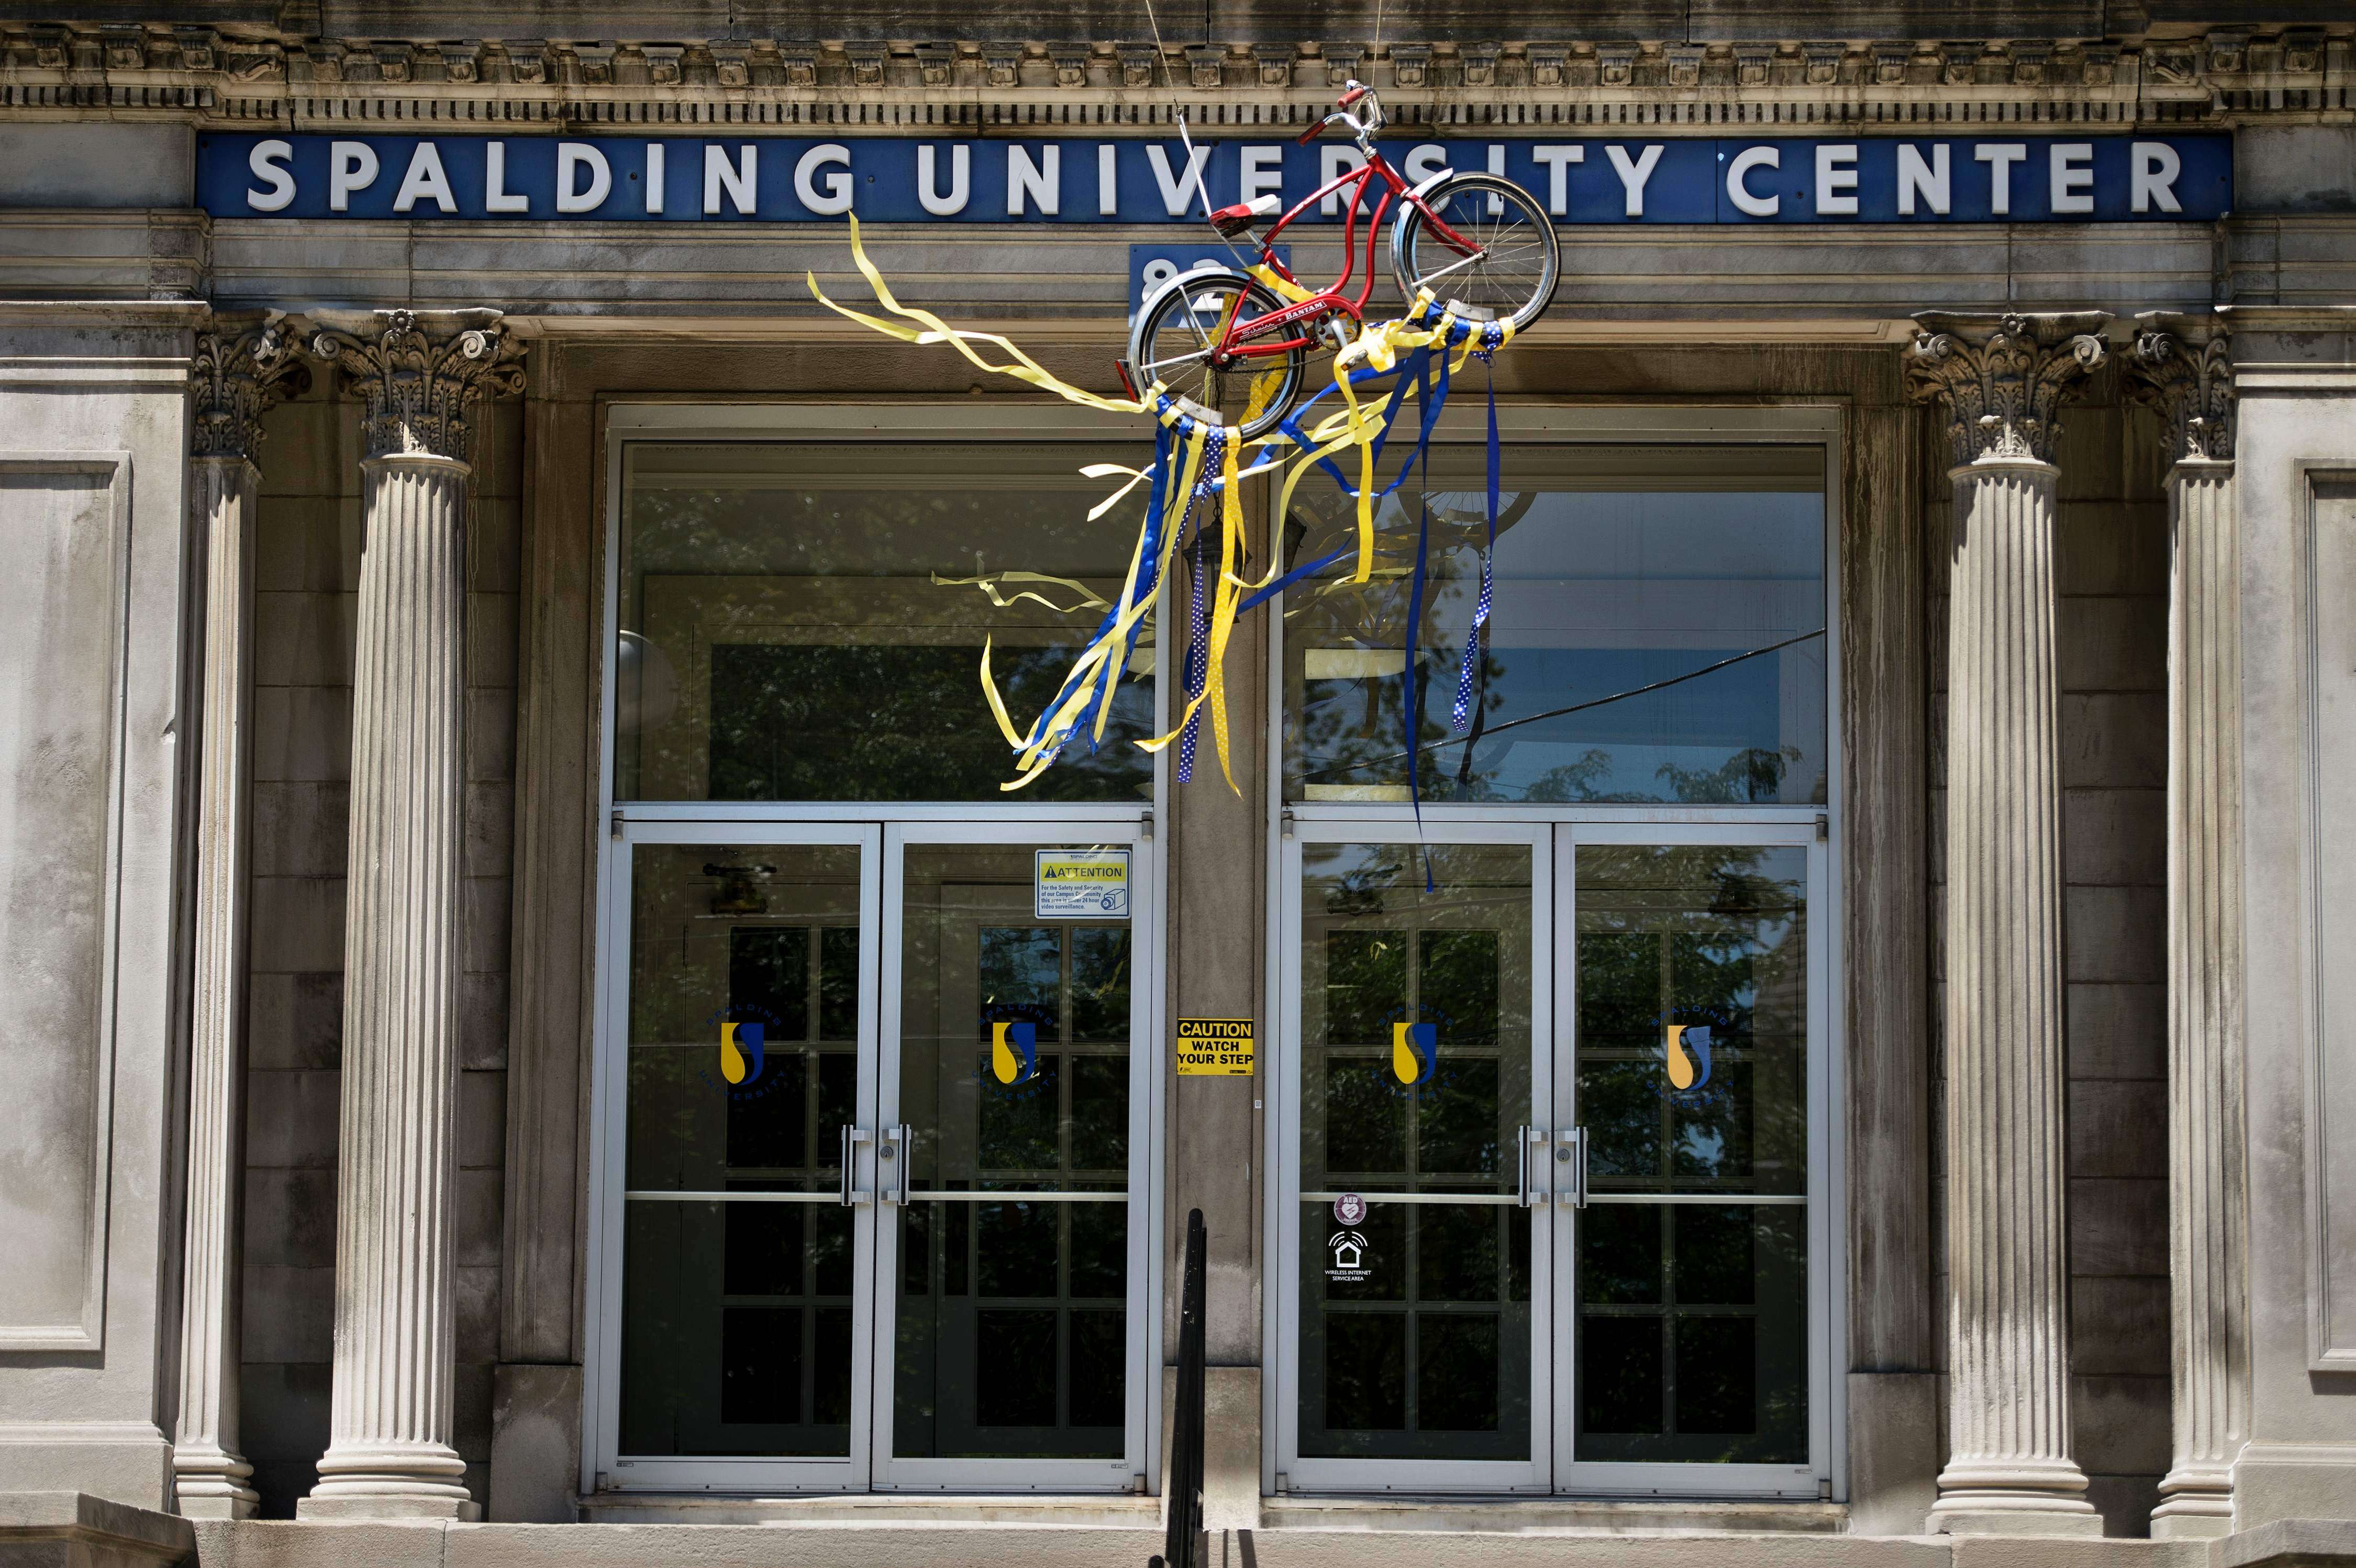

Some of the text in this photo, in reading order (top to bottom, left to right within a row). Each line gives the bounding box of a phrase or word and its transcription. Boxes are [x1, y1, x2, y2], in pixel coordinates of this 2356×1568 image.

[248, 139, 2182, 216] SPALDING UNIVERSITY CENTER
[1242, 301, 1323, 337] Schwinn BANTAM
[1058, 868, 1122, 877] ATTENTION
[706, 1004, 782, 1026] SPALDING
[979, 1004, 1053, 1026] SPALDING
[1378, 1004, 1454, 1027] SPALDING
[1651, 1005, 1729, 1027] SPALDING
[1180, 1022, 1251, 1037] CAUTION
[1192, 1041, 1239, 1051] WATCH
[1177, 1053, 1253, 1064] YOUR STEP
[699, 1070, 786, 1100] UNIVERSITY
[972, 1070, 1057, 1100] UNIVERSITY
